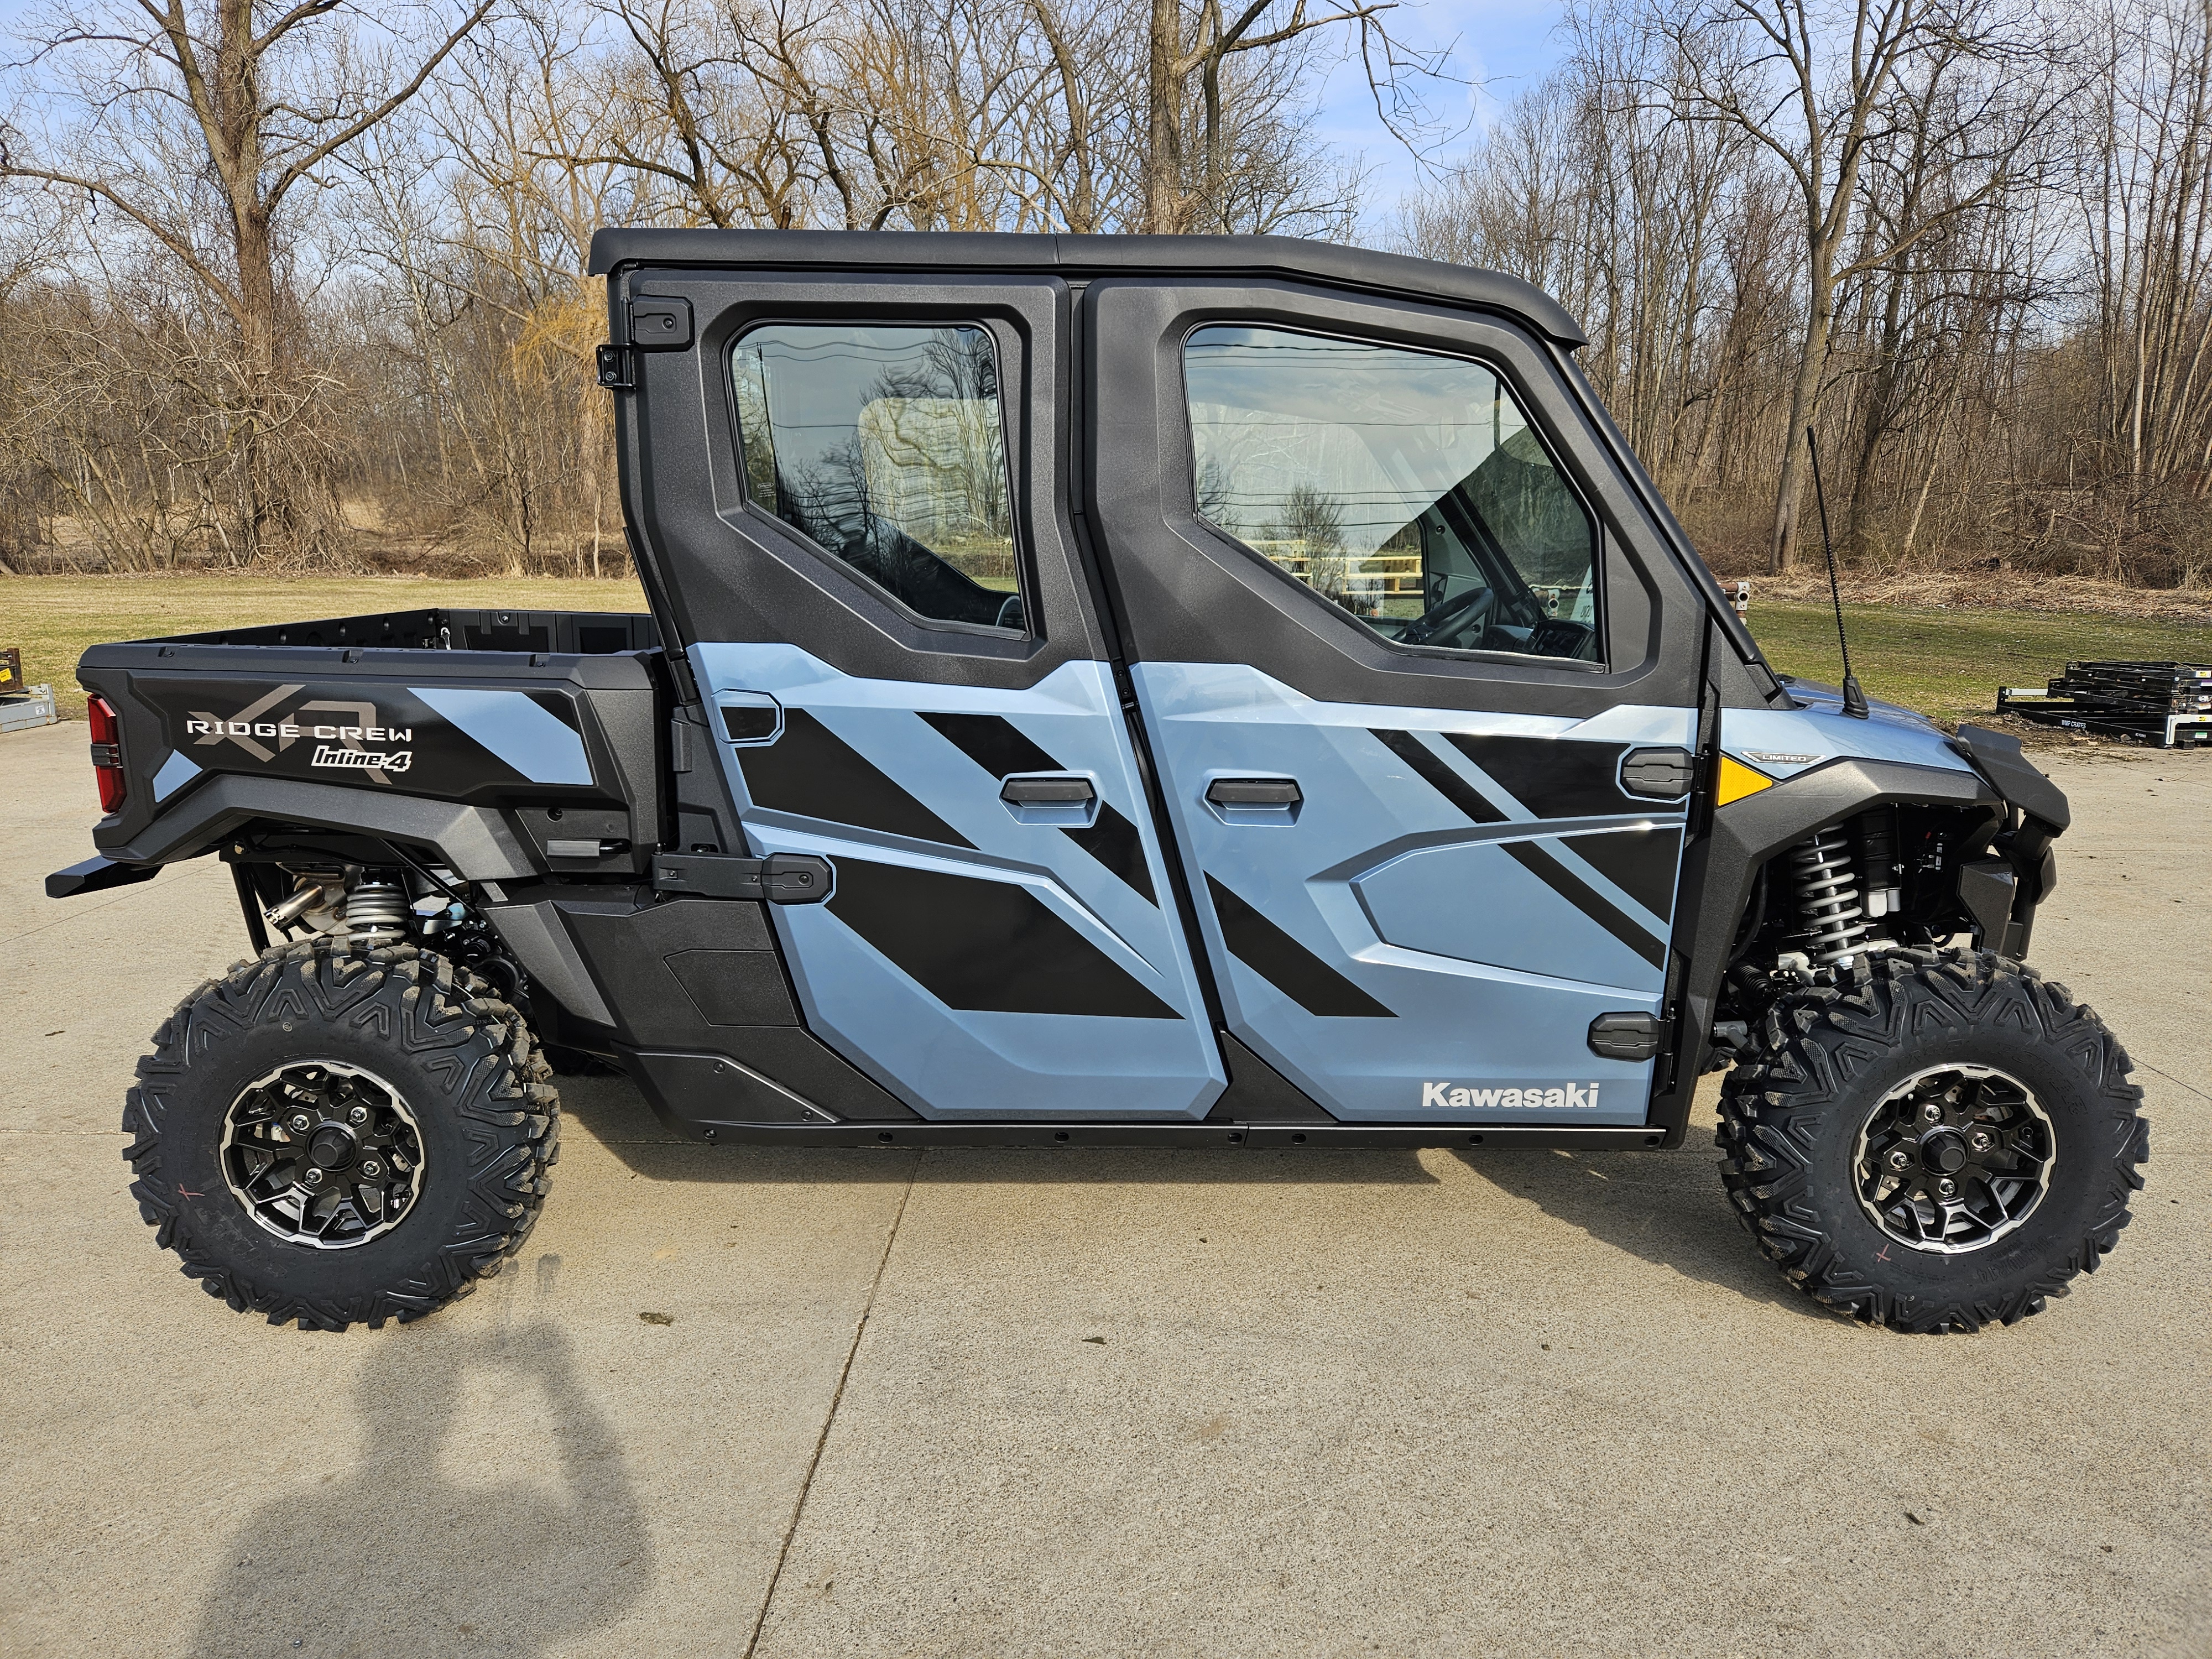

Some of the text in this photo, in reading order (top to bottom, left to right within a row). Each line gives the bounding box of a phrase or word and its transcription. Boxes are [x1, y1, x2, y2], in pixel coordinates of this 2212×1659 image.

[186, 719, 412, 742] RIDGE CREW
[2071, 721, 2086, 729] CRATES
[311, 745, 413, 772] Inline-4
[1422, 1082, 1599, 1108] Kawasaki
